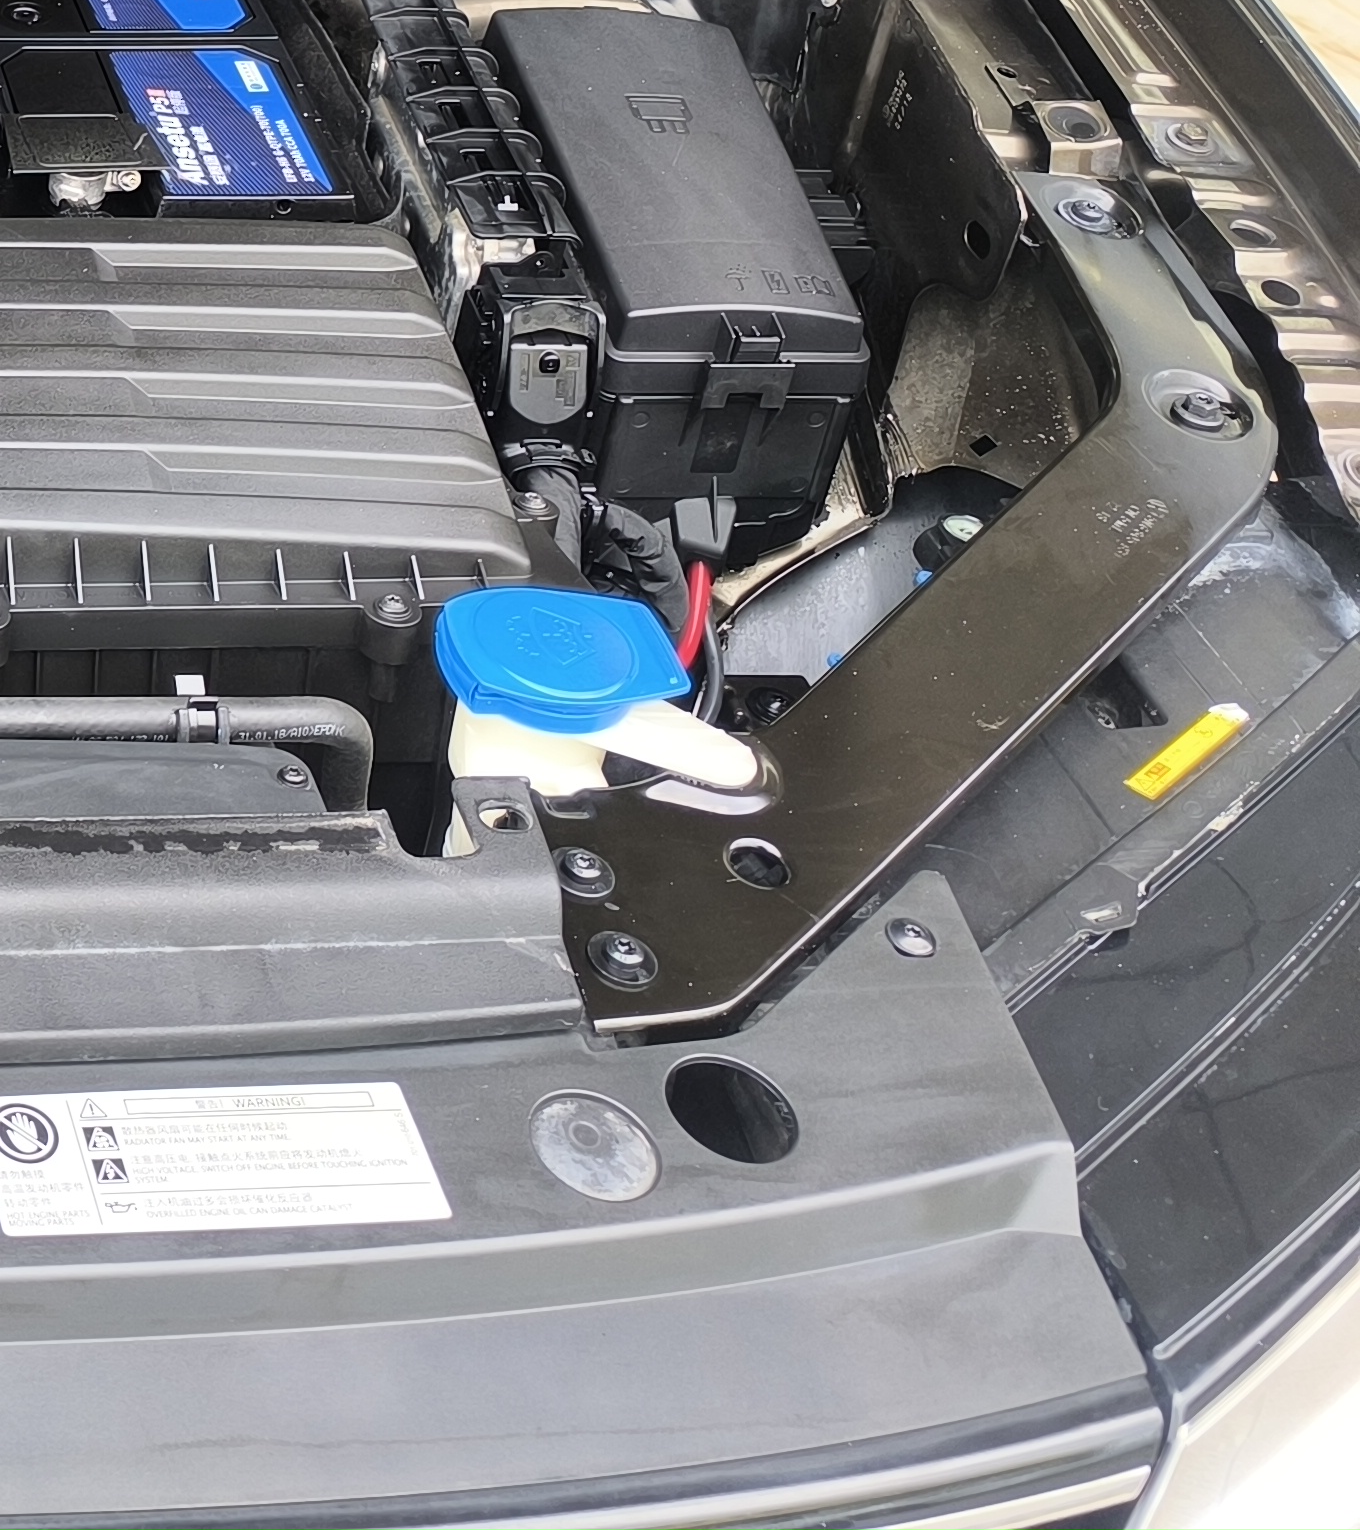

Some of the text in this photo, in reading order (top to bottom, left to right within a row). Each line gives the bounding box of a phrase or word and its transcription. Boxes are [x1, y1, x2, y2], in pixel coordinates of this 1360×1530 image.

[297, 168, 316, 181] 12V
[232, 1096, 306, 1109] WARNING!
[123, 1137, 167, 1146] RADIATOR
[187, 1136, 205, 1144] MAY
[207, 1135, 234, 1143] START
[250, 1134, 267, 1142] ANY
[132, 1167, 155, 1175] HIGH
[201, 1164, 234, 1173] SWITCH
[236, 1163, 251, 1171] OFF
[254, 1163, 285, 1171] ENGINE
[288, 1161, 319, 1170] BEFORE
[322, 1159, 367, 1168] TOUCHING
[369, 1158, 408, 1167] IGNITION
[6, 1209, 90, 1220] HOT ENGINE PARTS
[146, 1208, 197, 1218] OVERFILLED
[199, 1207, 230, 1217] ENGINE
[233, 1207, 247, 1216] OIL
[249, 1206, 269, 1215] CAN
[271, 1205, 307, 1214] DAMAGE
[8, 1217, 75, 1227] MOVING PARTS
